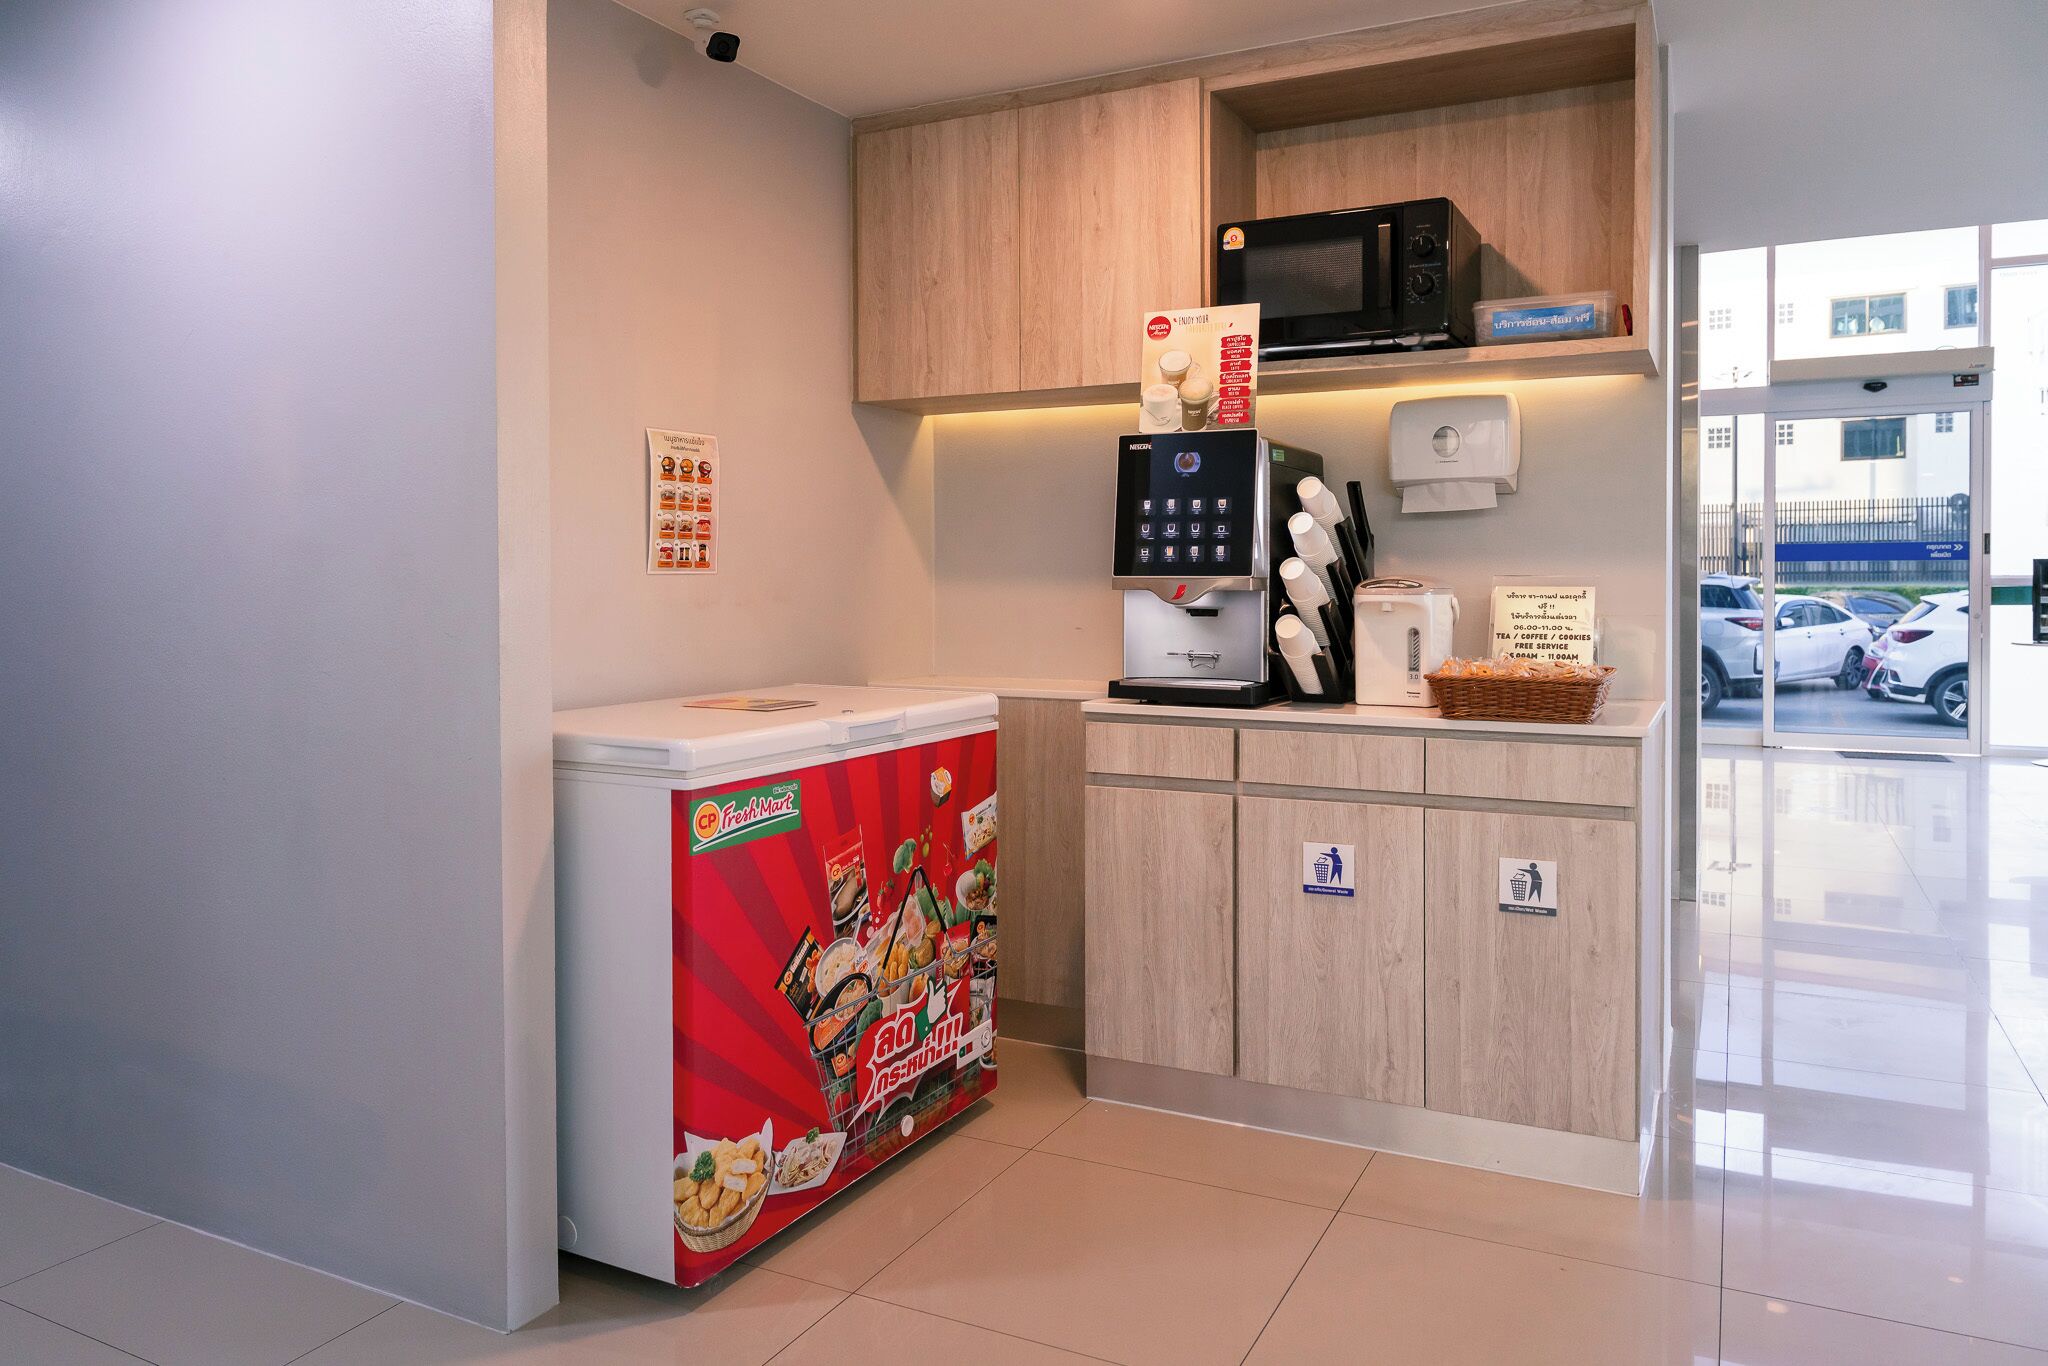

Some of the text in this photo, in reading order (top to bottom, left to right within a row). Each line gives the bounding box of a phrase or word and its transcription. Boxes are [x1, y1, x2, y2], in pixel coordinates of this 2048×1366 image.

[1178, 314, 1209, 325] ENJOY YOUR
[1496, 632, 1511, 640] TEA
[1548, 653, 1579, 661] 11.00AM
[698, 813, 717, 830] CP
[876, 1015, 914, 1059] ลด
